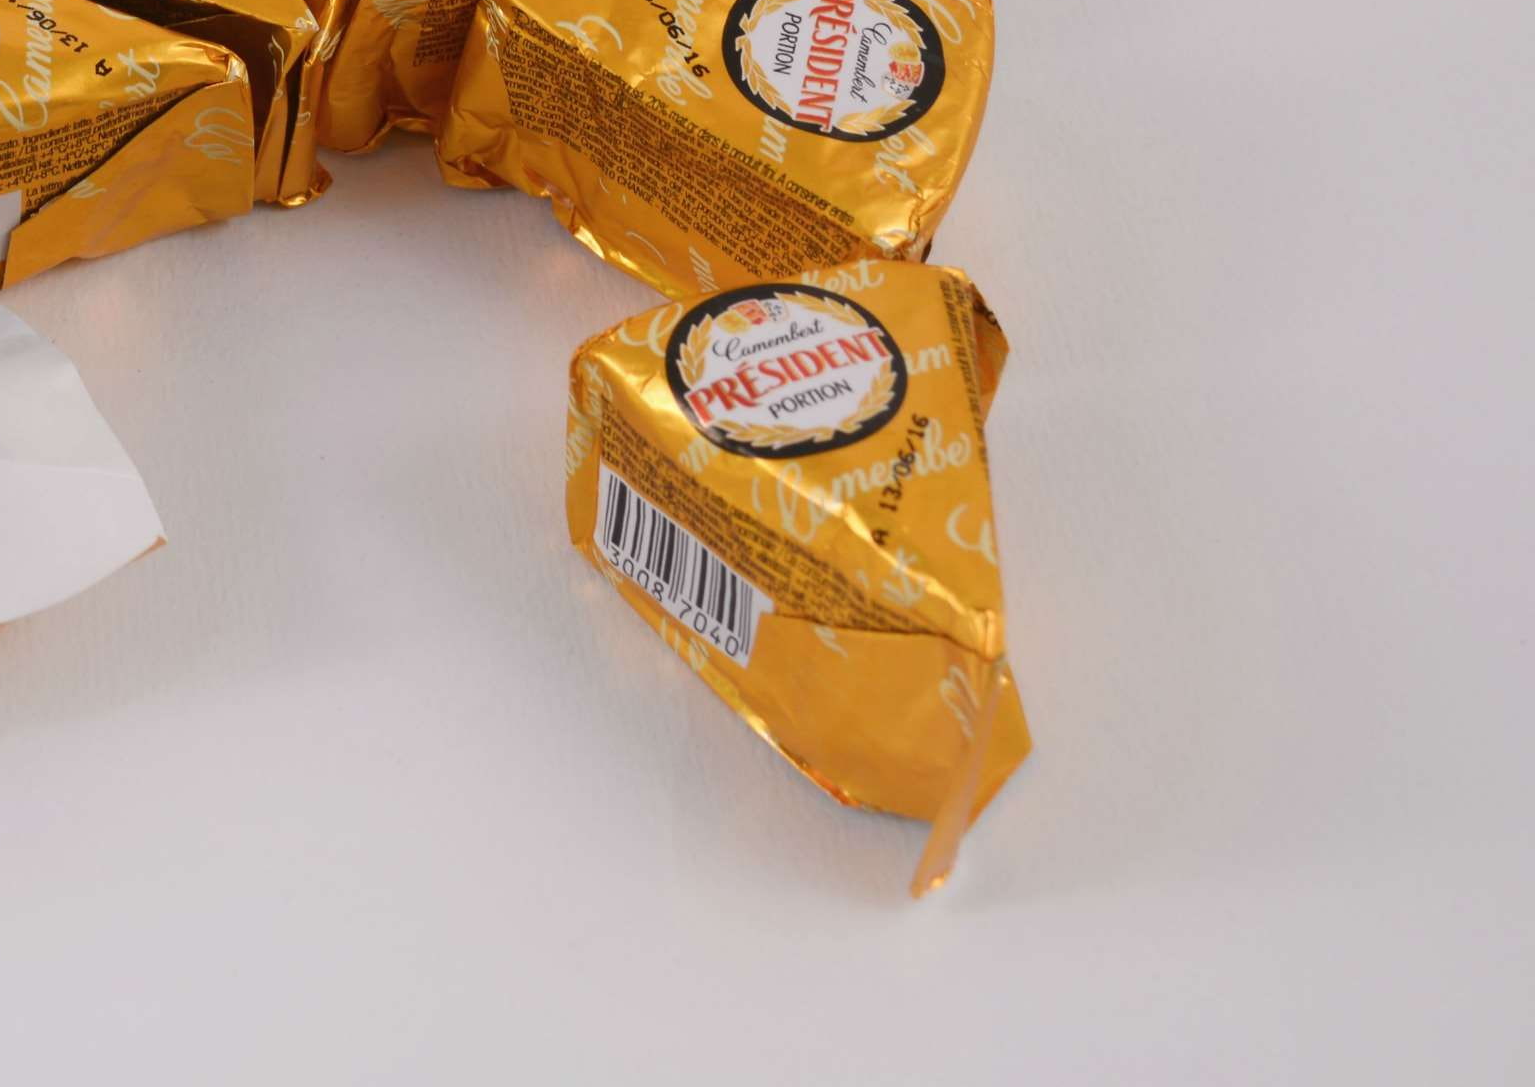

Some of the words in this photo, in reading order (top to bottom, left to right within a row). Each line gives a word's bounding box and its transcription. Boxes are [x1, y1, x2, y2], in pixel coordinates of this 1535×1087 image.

[775, 11, 802, 76] PORTION
[855, 21, 893, 105] Camembert
[686, 329, 891, 424] PRÉSIDENT
[712, 317, 825, 364] Camembert
[768, 377, 854, 420] PORTION
[879, 413, 932, 513] 13/06/16
[608, 548, 665, 603] 3008
[677, 597, 740, 660] 7040
